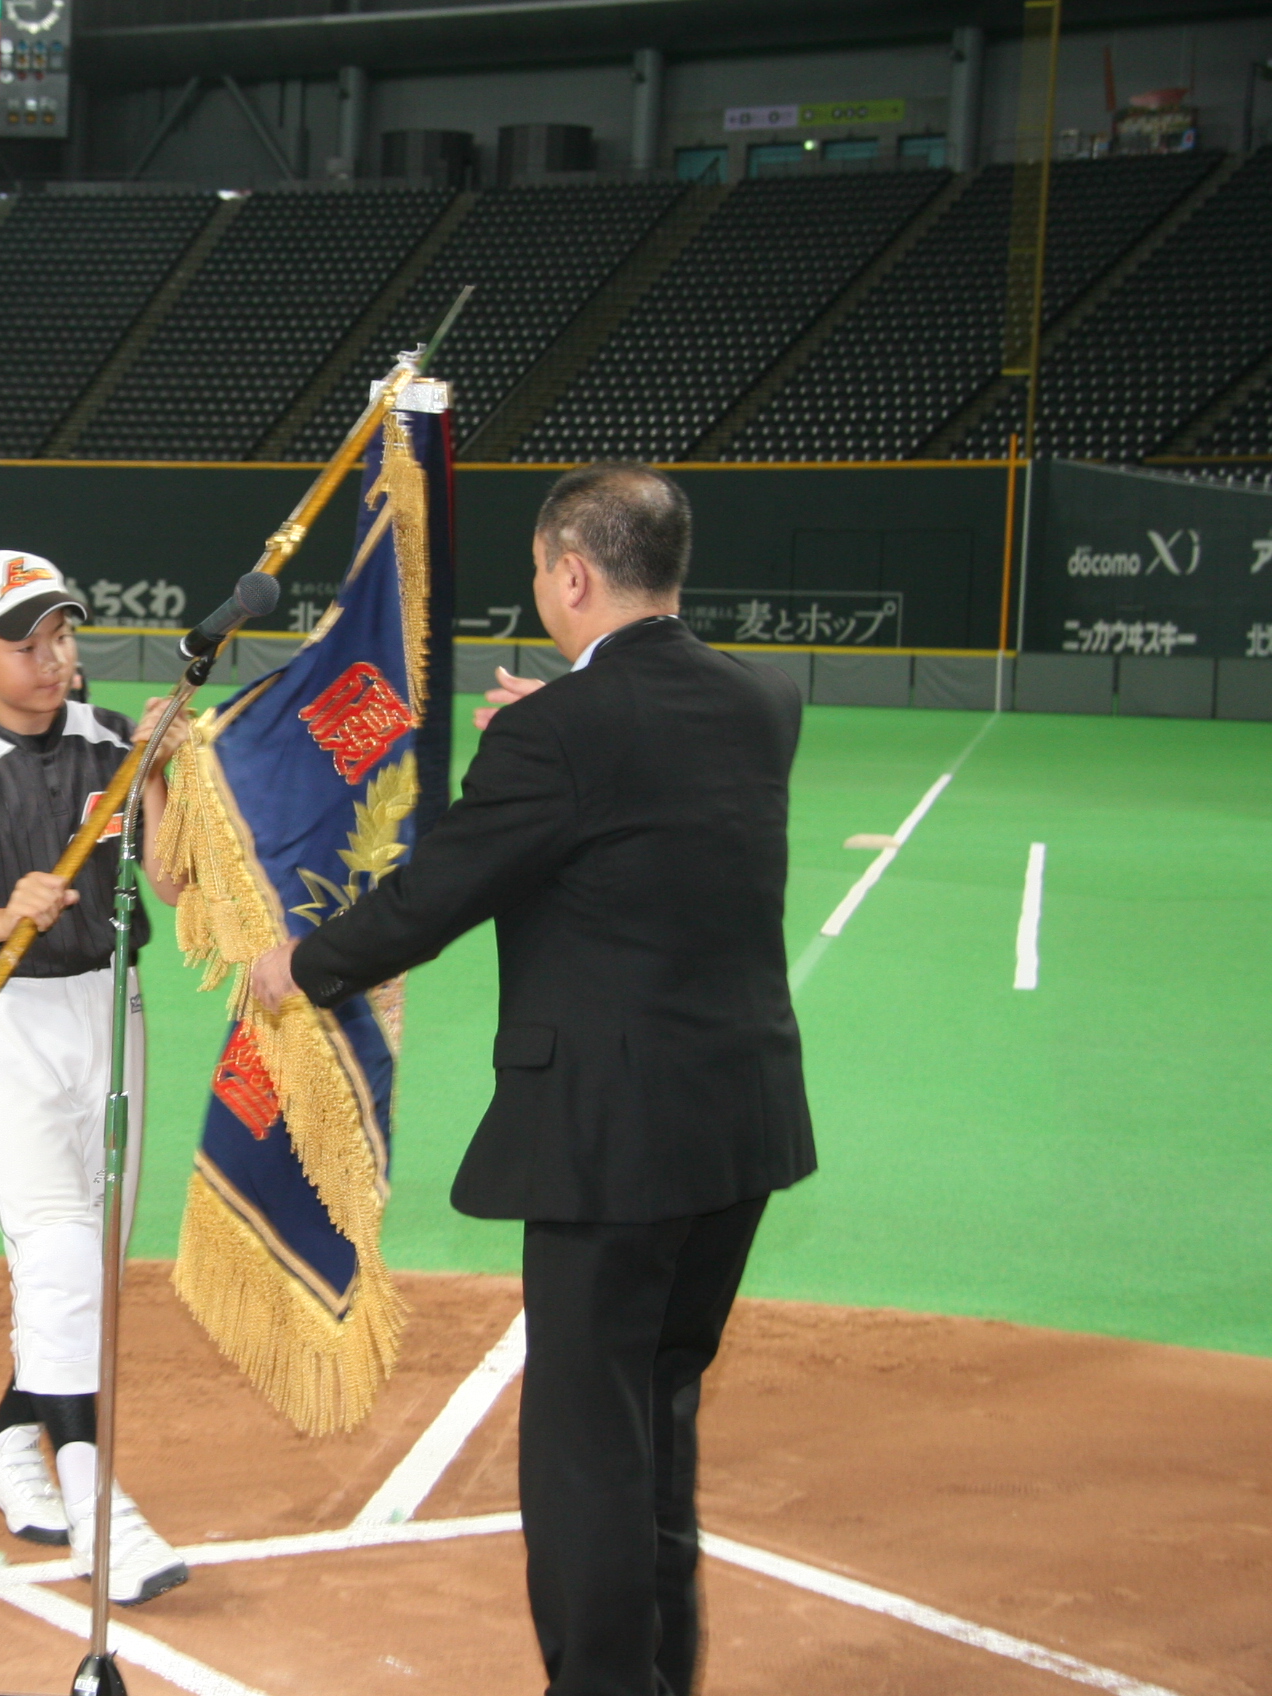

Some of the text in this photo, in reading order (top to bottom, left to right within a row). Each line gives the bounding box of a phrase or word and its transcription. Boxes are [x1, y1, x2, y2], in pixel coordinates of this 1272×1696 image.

[1067, 546, 1141, 577] docomo
[734, 599, 897, 644] 麦とホップ
